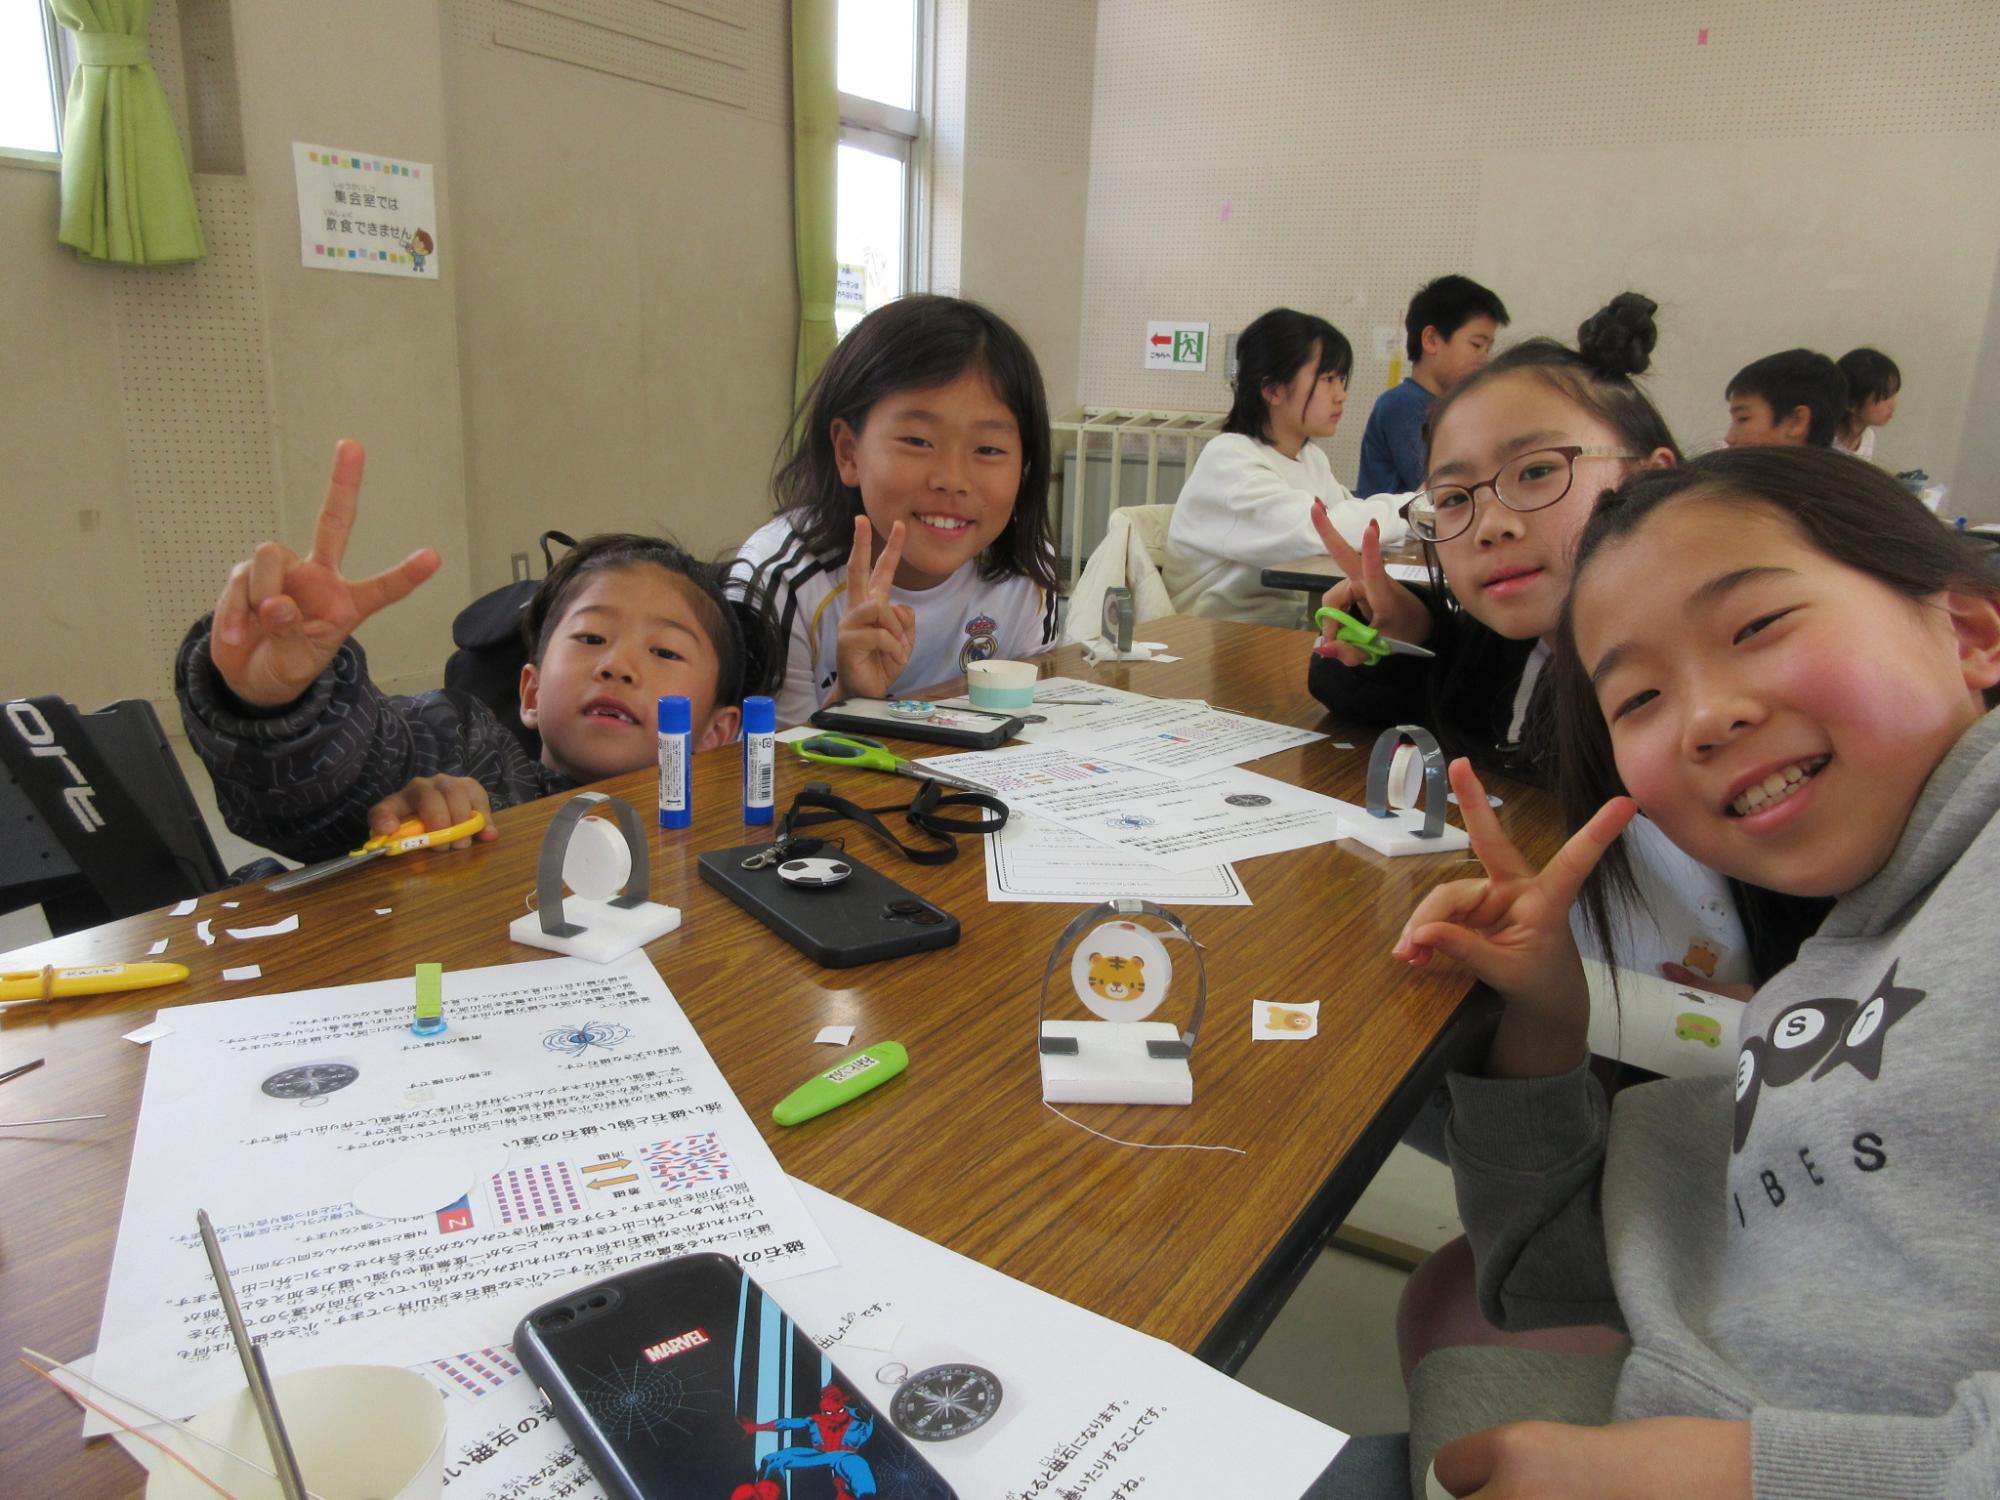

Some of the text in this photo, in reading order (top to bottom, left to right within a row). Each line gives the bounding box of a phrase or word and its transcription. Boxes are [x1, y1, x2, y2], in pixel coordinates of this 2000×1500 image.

[334, 190, 399, 211] 集会室では
[326, 217, 413, 240] 飲食できません
[500, 1101, 723, 1149] 強い磁石と弱い磁石の違い
[448, 1216, 466, 1228] N
[183, 1195, 755, 1322] 打ち消しあって外に出てきません。ところが一度無理やり強い磁力を加えると部が
[733, 1239, 806, 1265] 磁石の
[177, 1223, 772, 1360] 磁石になれる金属などは元々すごく小さな磁石を沢山持ってます。小さな磁は何も
[818, 1300, 894, 1351] 出したです。
[646, 1330, 709, 1361] MARVEL
[441, 1405, 557, 1486] い磁石の
